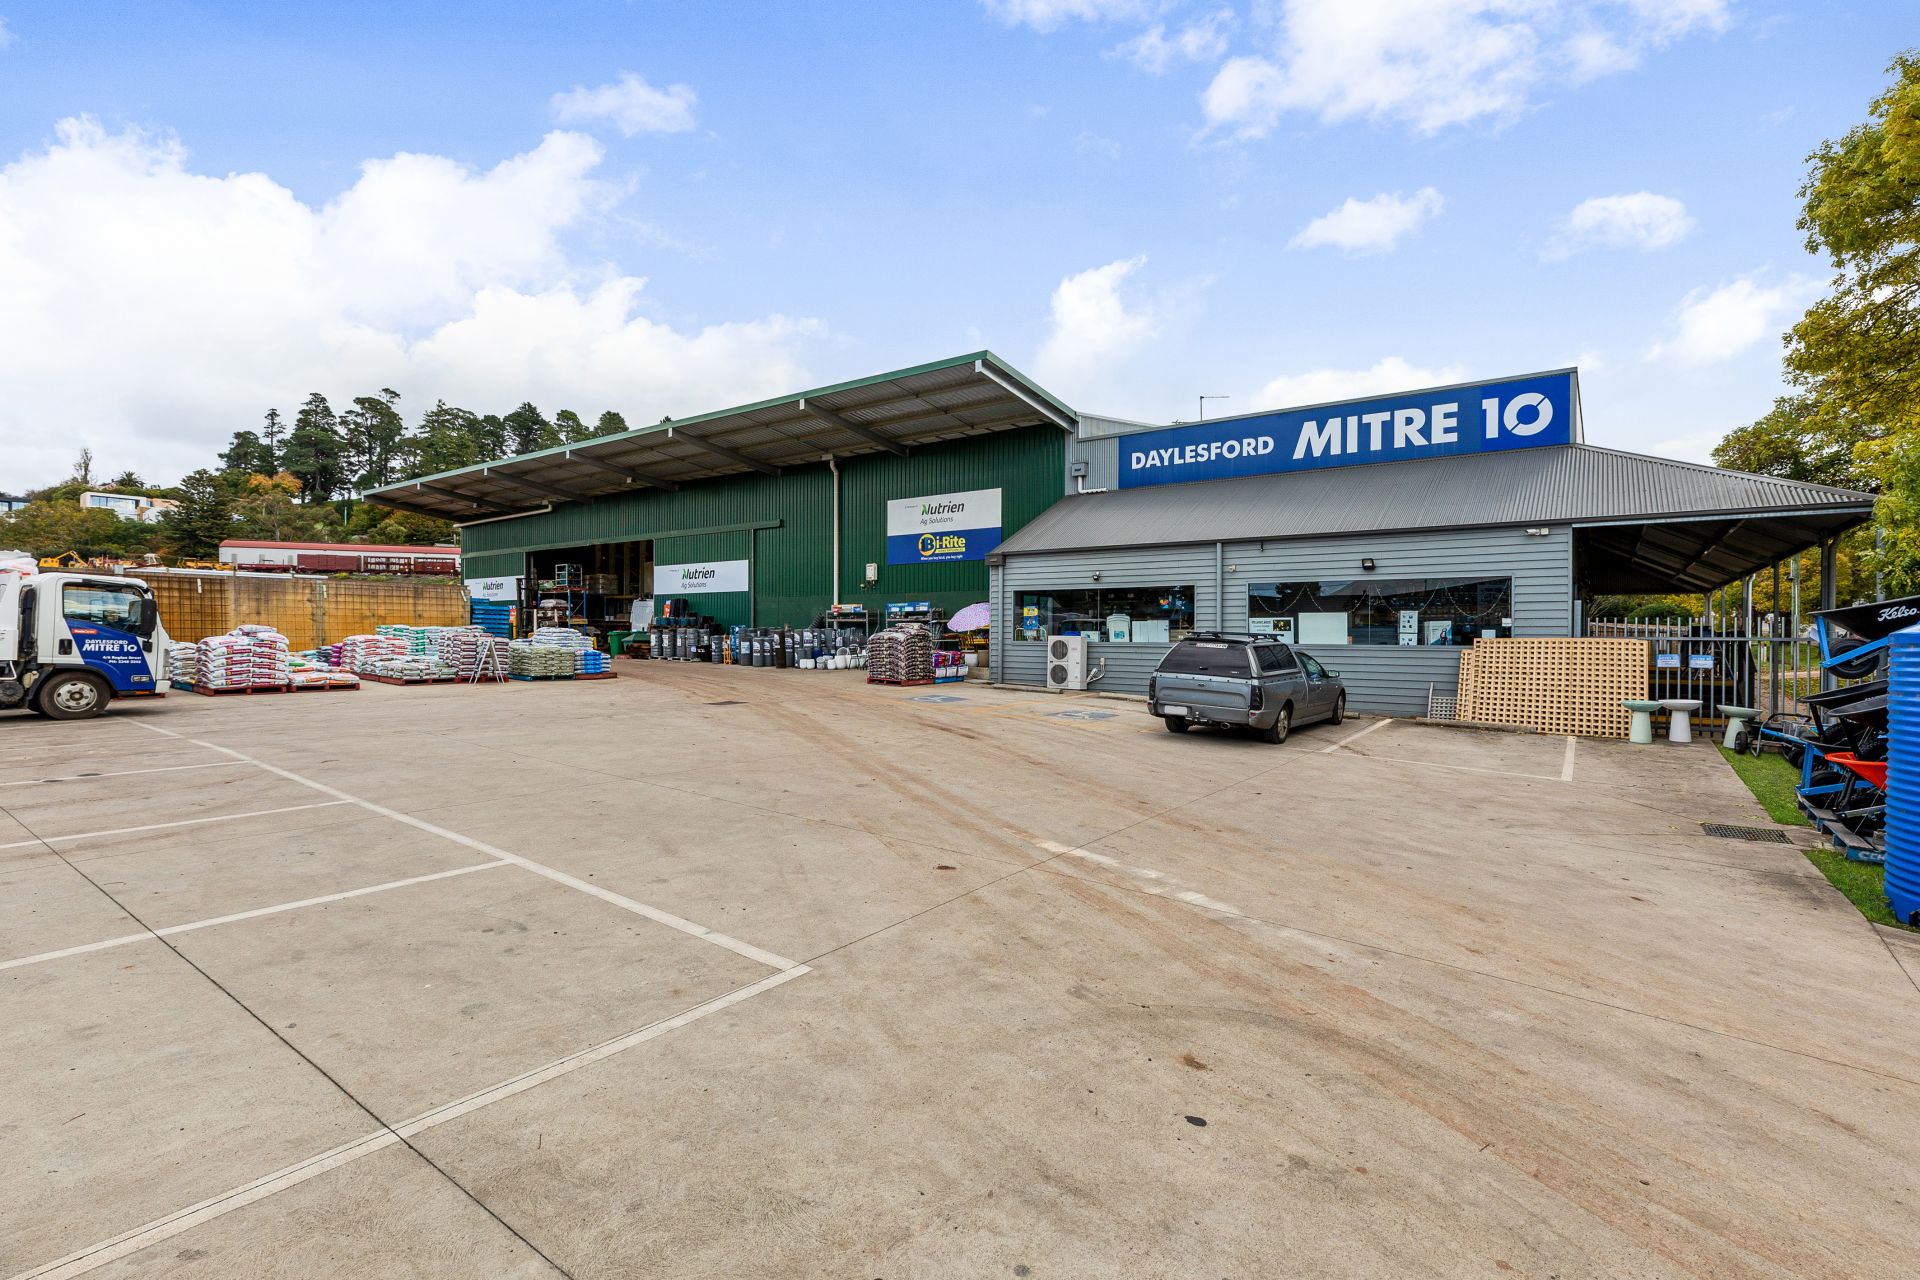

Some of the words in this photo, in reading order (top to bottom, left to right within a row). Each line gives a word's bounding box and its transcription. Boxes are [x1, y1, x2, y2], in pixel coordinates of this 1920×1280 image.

[1131, 435, 1275, 470] DAYLESFORD
[1292, 402, 1459, 460] MITRE
[1481, 391, 1554, 440] 10
[921, 500, 965, 516] Nutrien
[920, 518, 928, 526] Ag
[928, 516, 954, 525] Solutions
[919, 534, 966, 554] Bi-Rite
[682, 566, 716, 580] Nutrien
[482, 580, 504, 591] Nutrien
[82, 643, 120, 652] MITRE
[123, 644, 138, 652] 10
